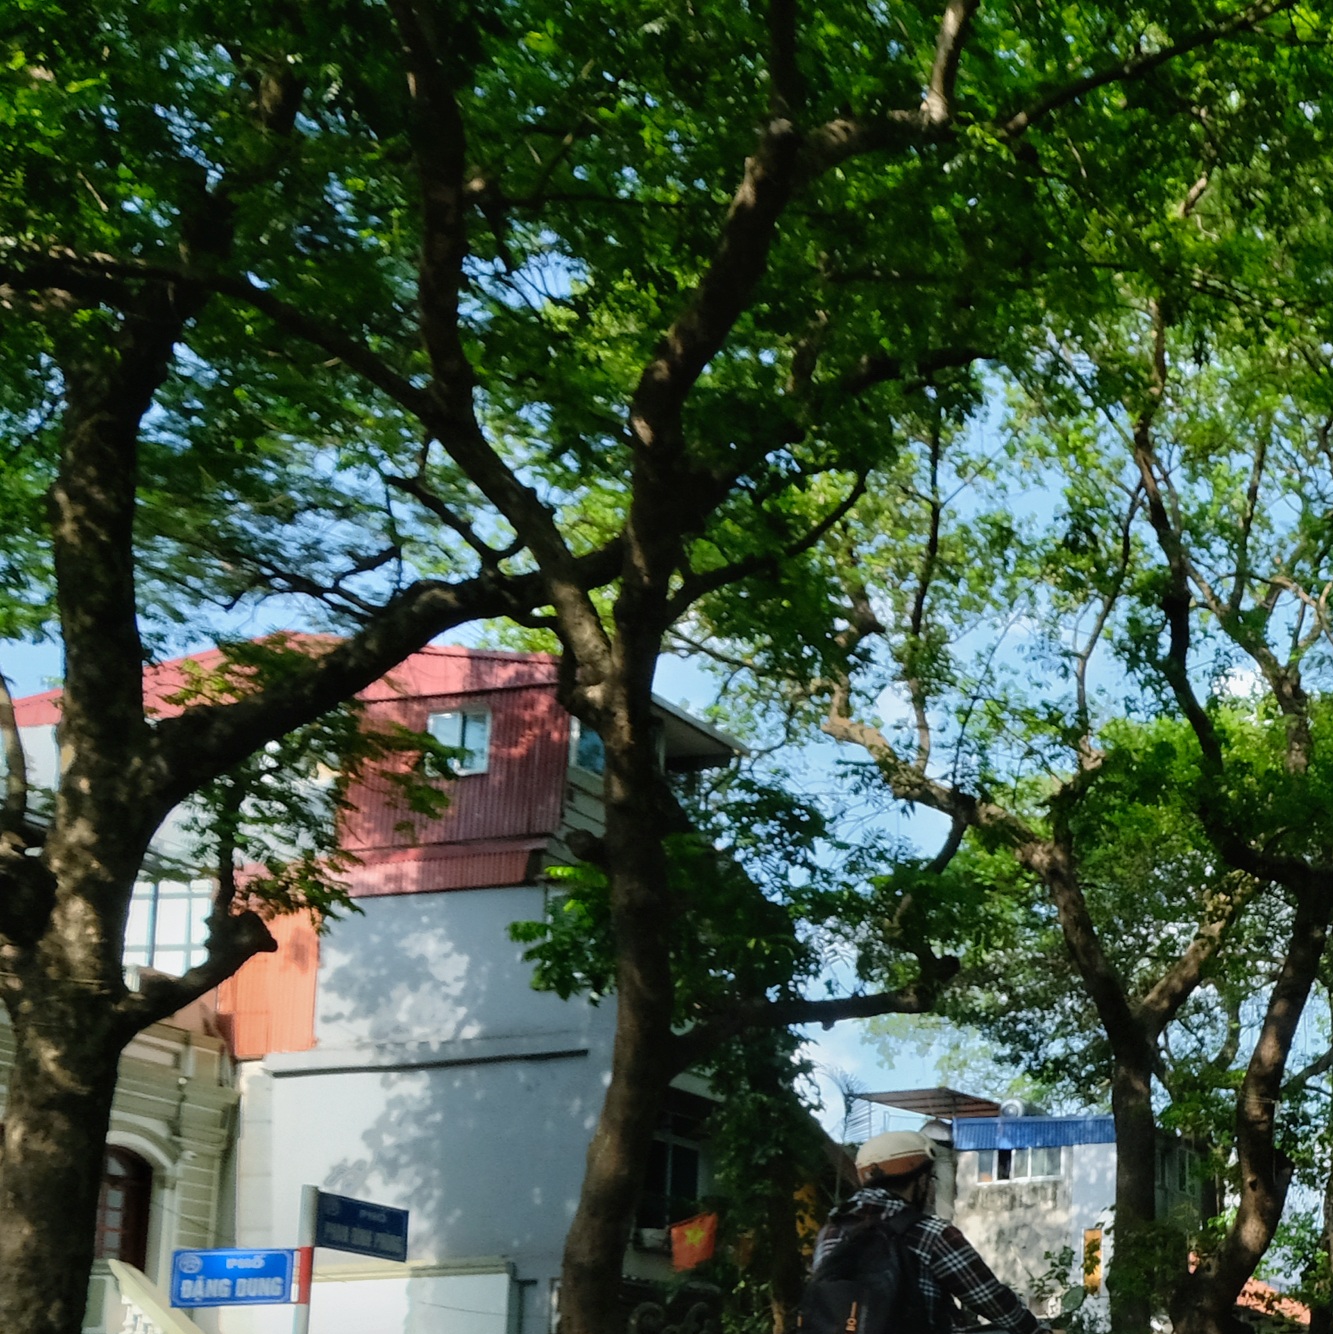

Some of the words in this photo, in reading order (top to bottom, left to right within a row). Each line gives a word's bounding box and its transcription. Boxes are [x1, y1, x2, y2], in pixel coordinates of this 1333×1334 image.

[226, 1255, 266, 1269] PHỐ
[181, 1276, 232, 1301] ĐẶNG
[235, 1277, 283, 1297] DUNG
